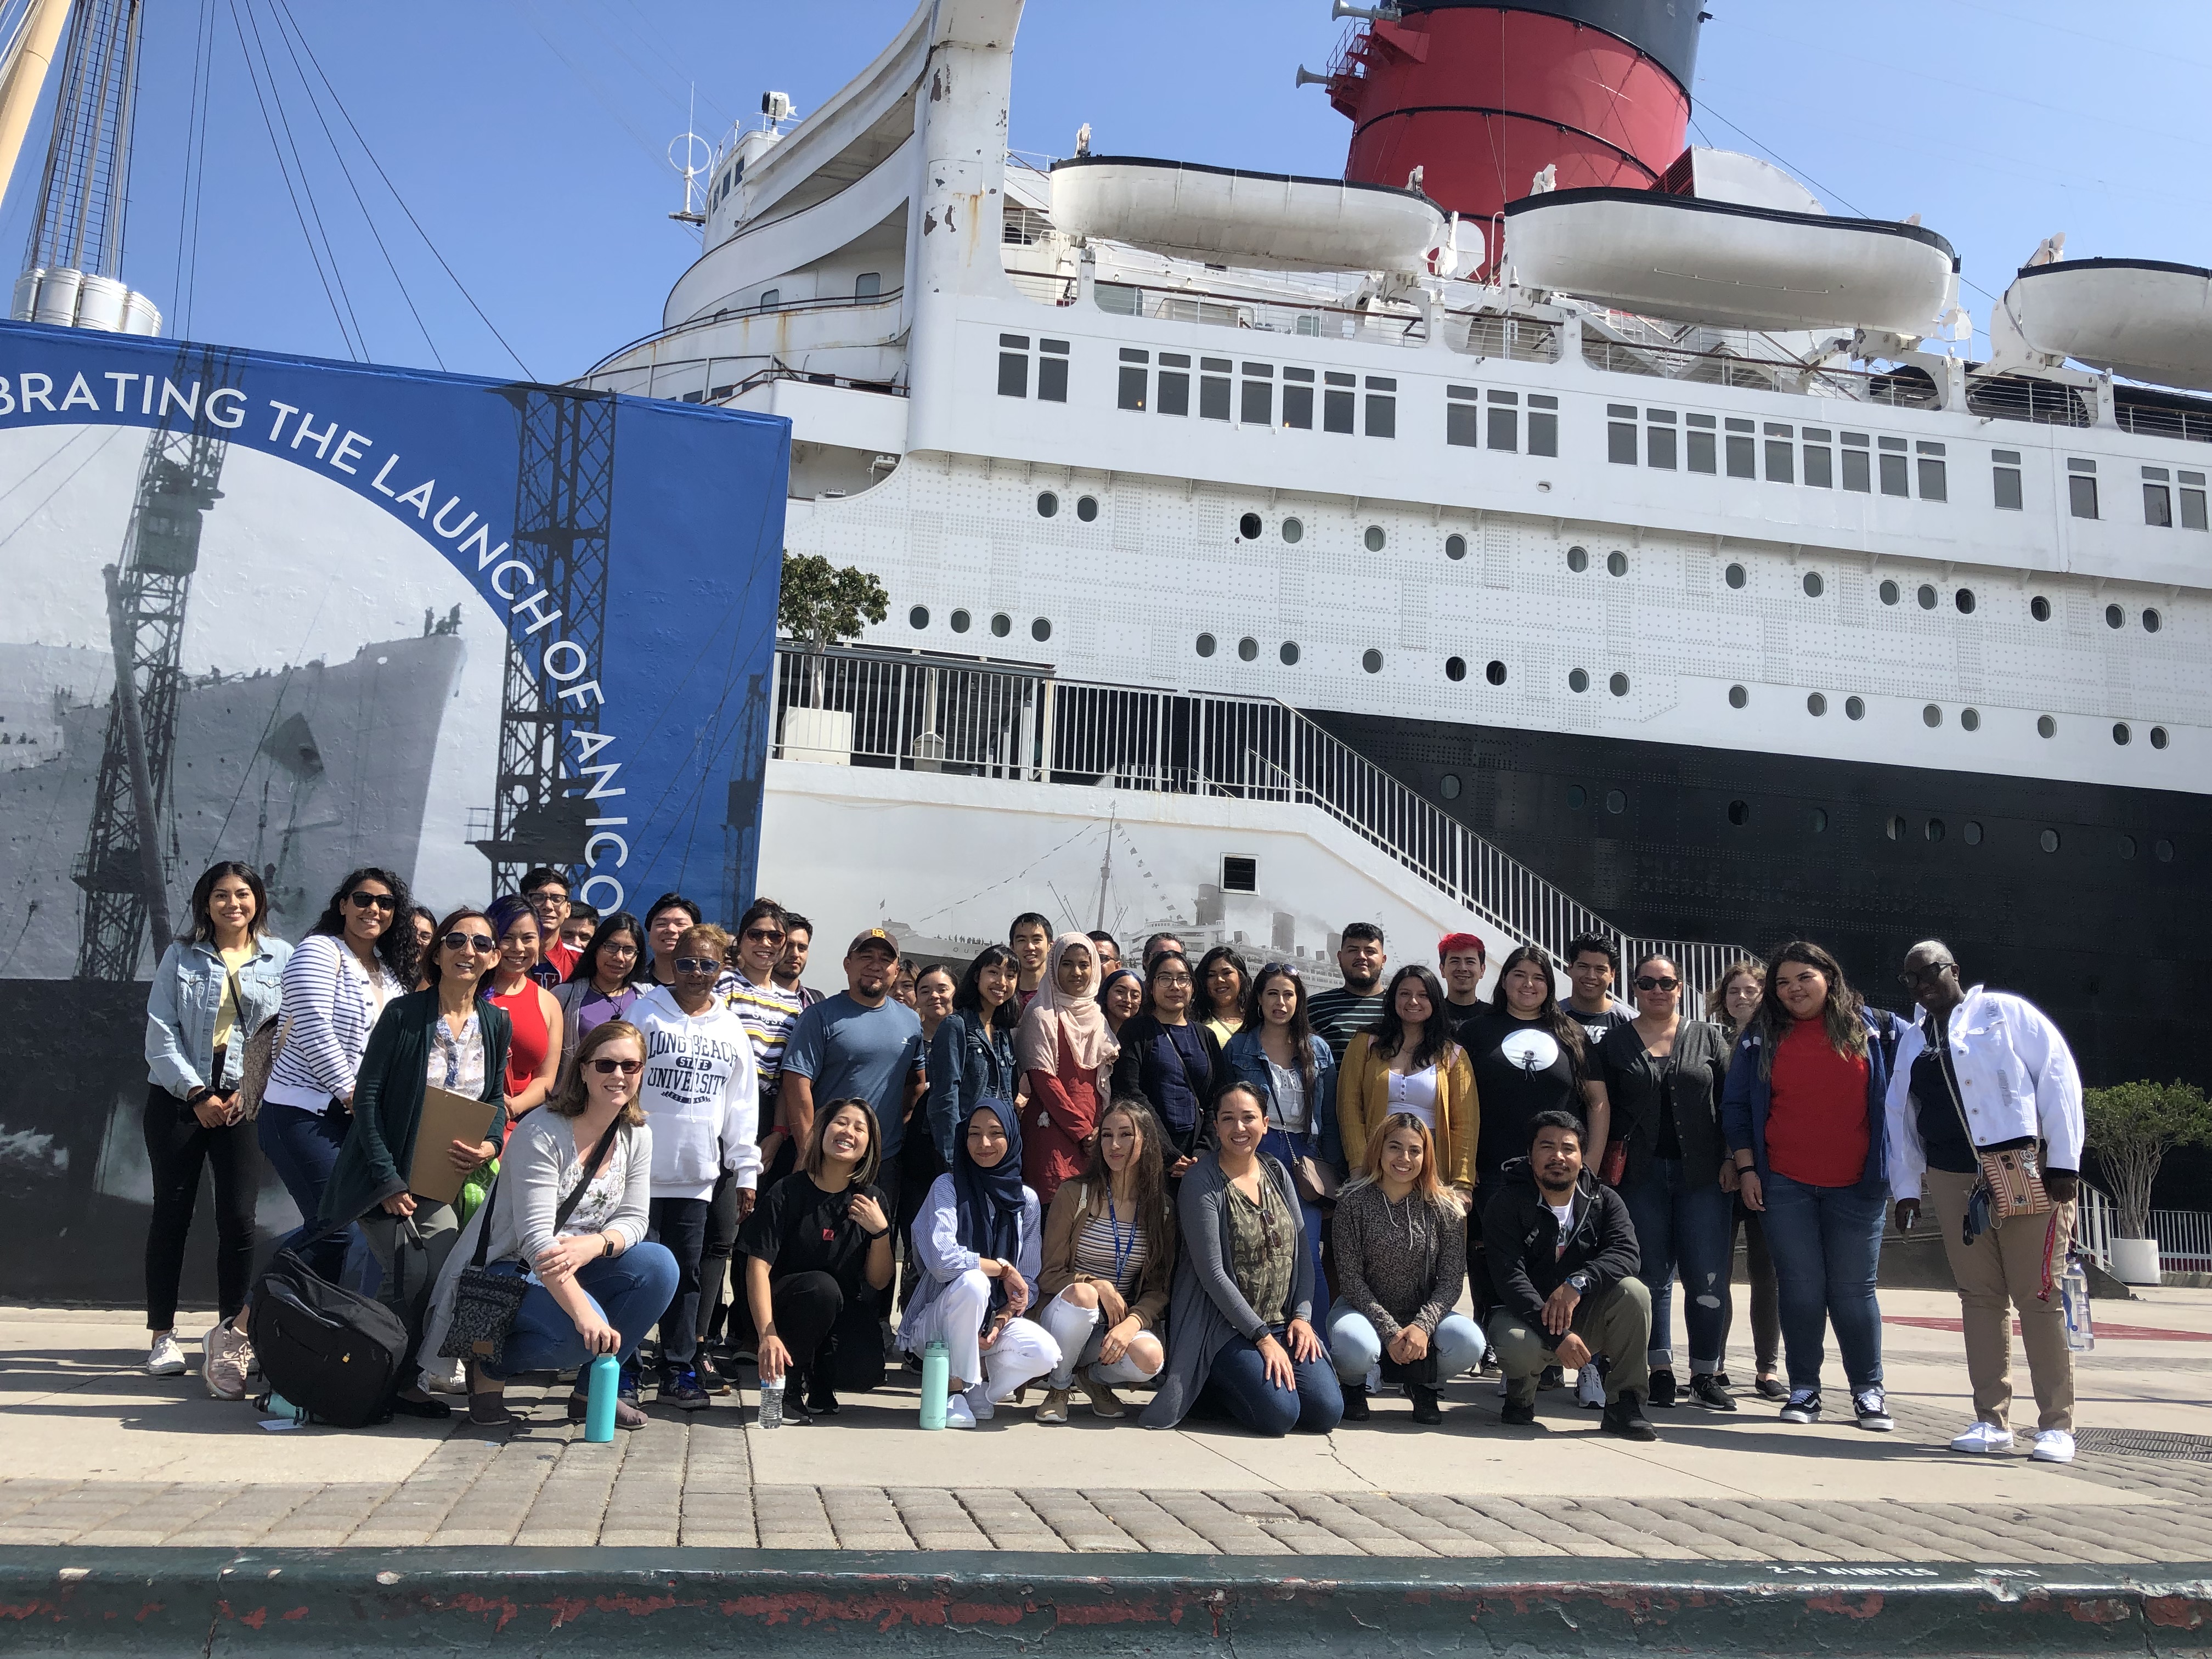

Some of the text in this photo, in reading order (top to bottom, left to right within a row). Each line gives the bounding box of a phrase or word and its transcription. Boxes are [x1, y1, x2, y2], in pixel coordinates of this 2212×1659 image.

[269, 400, 373, 475] THE
[371, 453, 563, 635] LAUNCH
[543, 640, 605, 709] OF
[571, 729, 626, 799] AN
[580, 817, 628, 917] ICO
[647, 1030, 738, 1070] LONG BEACH
[647, 1067, 728, 1096] UNIVERSITY
[1765, 1566, 2042, 1577] 2-5 MINUTES ONLY
